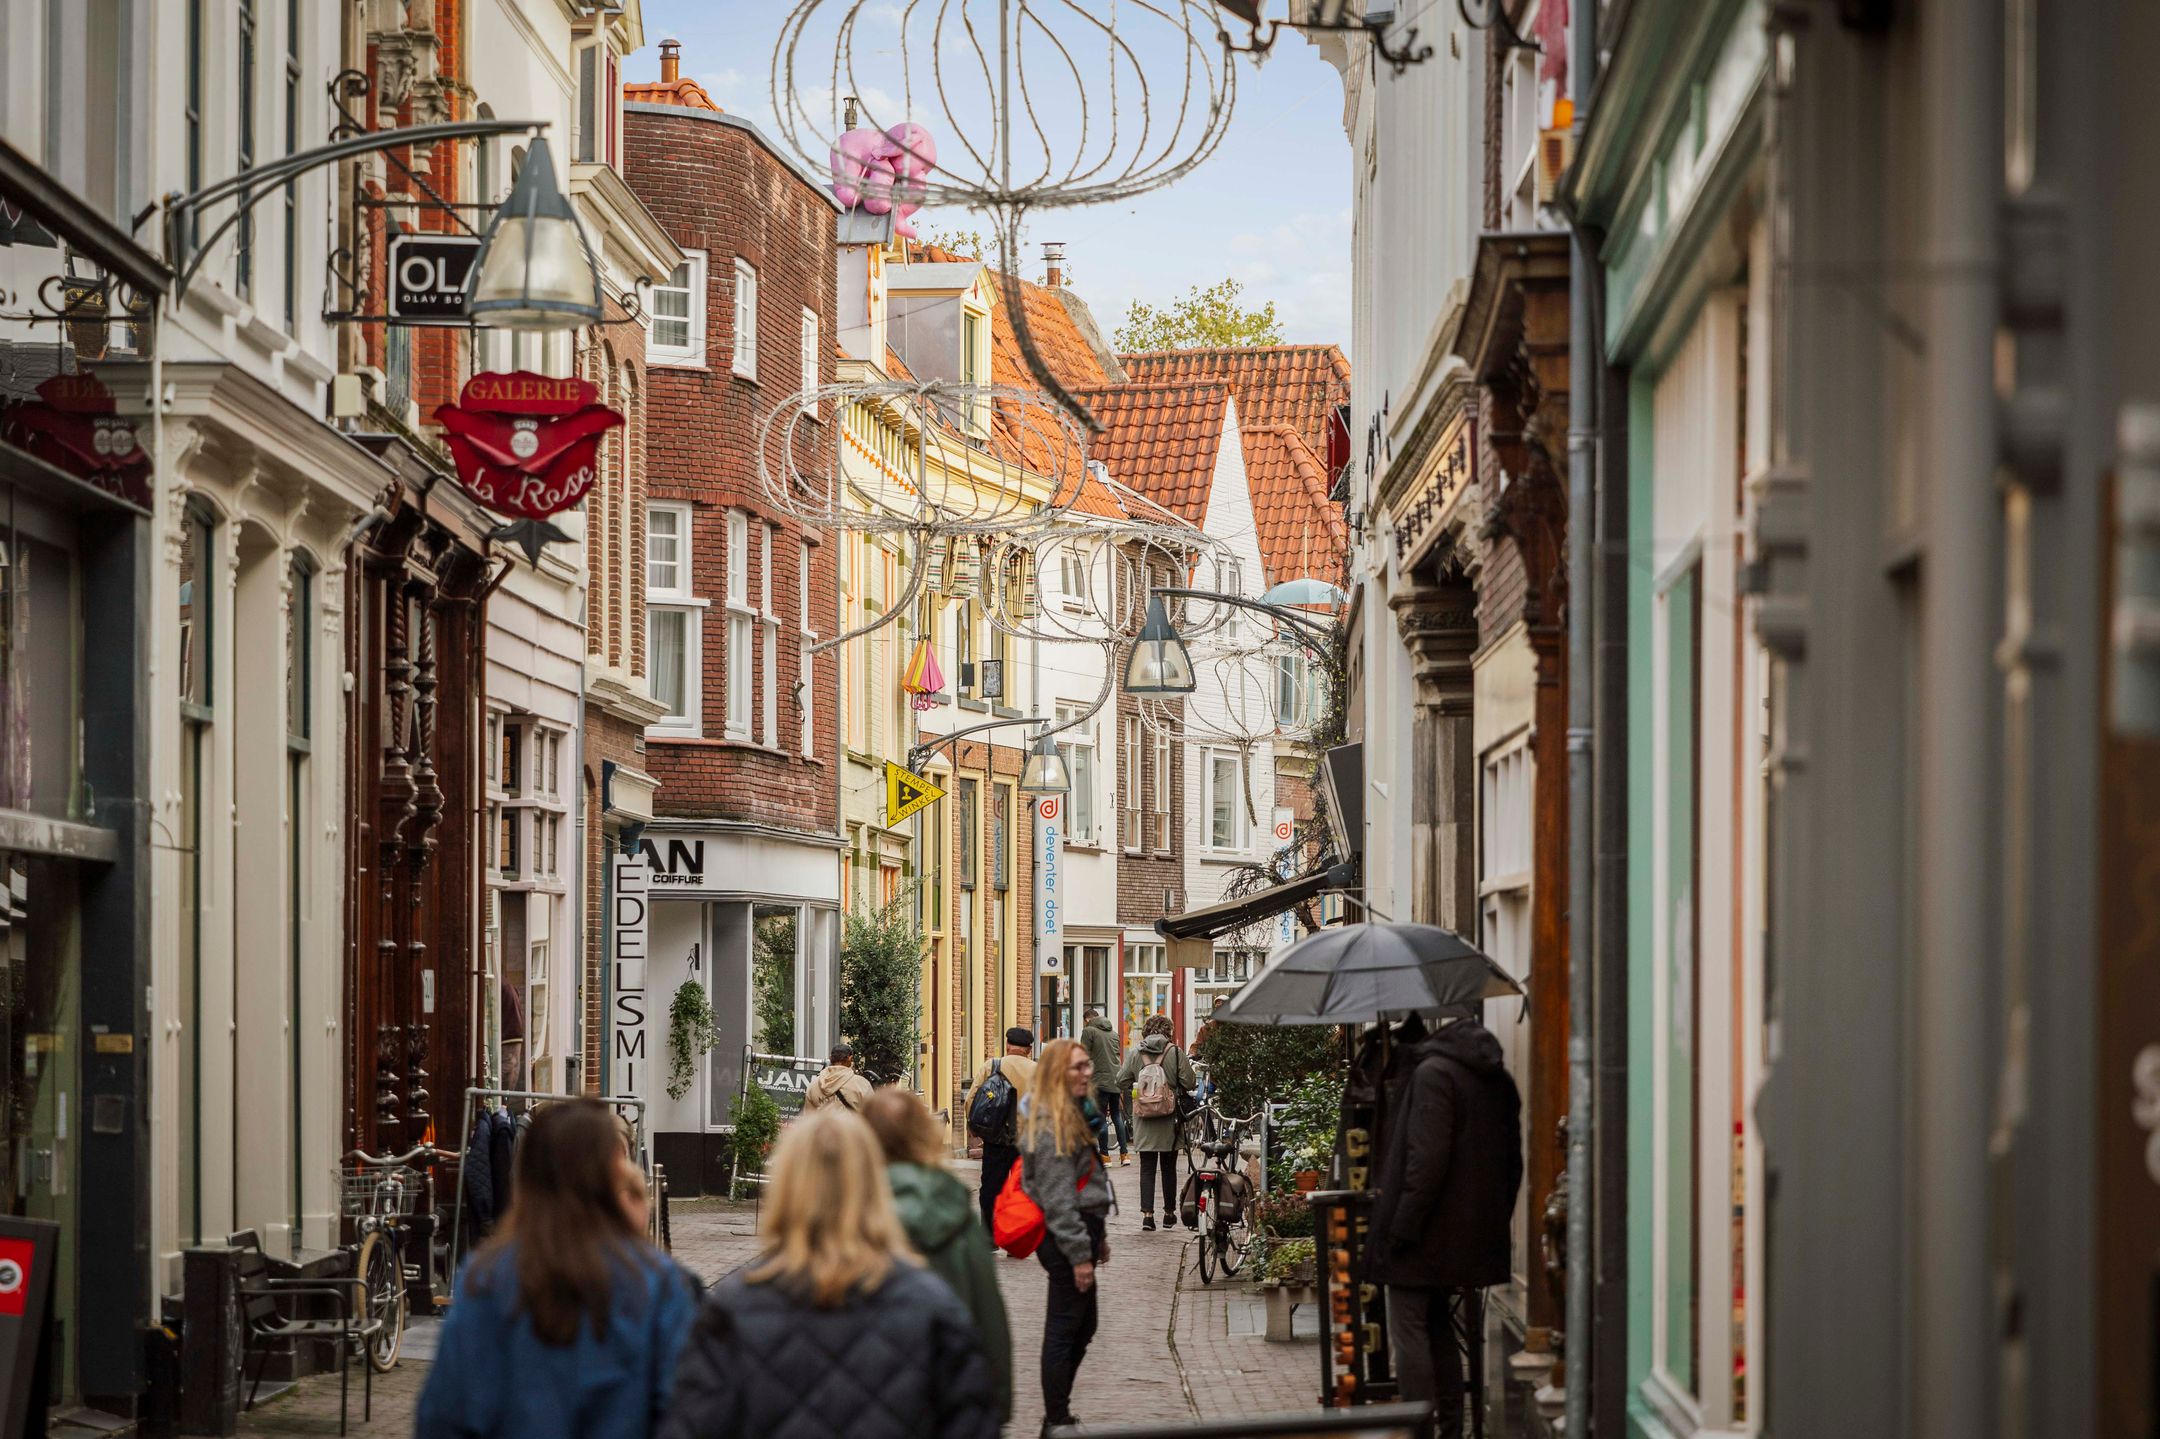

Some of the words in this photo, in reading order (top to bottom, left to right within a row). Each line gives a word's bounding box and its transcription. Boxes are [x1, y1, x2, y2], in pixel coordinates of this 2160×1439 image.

[403, 294, 437, 303] OLAV
[467, 379, 581, 401] GALERIE
[468, 467, 496, 503] La
[508, 465, 594, 511] Rose
[894, 768, 936, 798] STEMPEL
[1045, 826, 1059, 894] deventer
[652, 874, 704, 885] COIFFURE
[1045, 899, 1059, 935] doet
[757, 1070, 818, 1088] JAN
